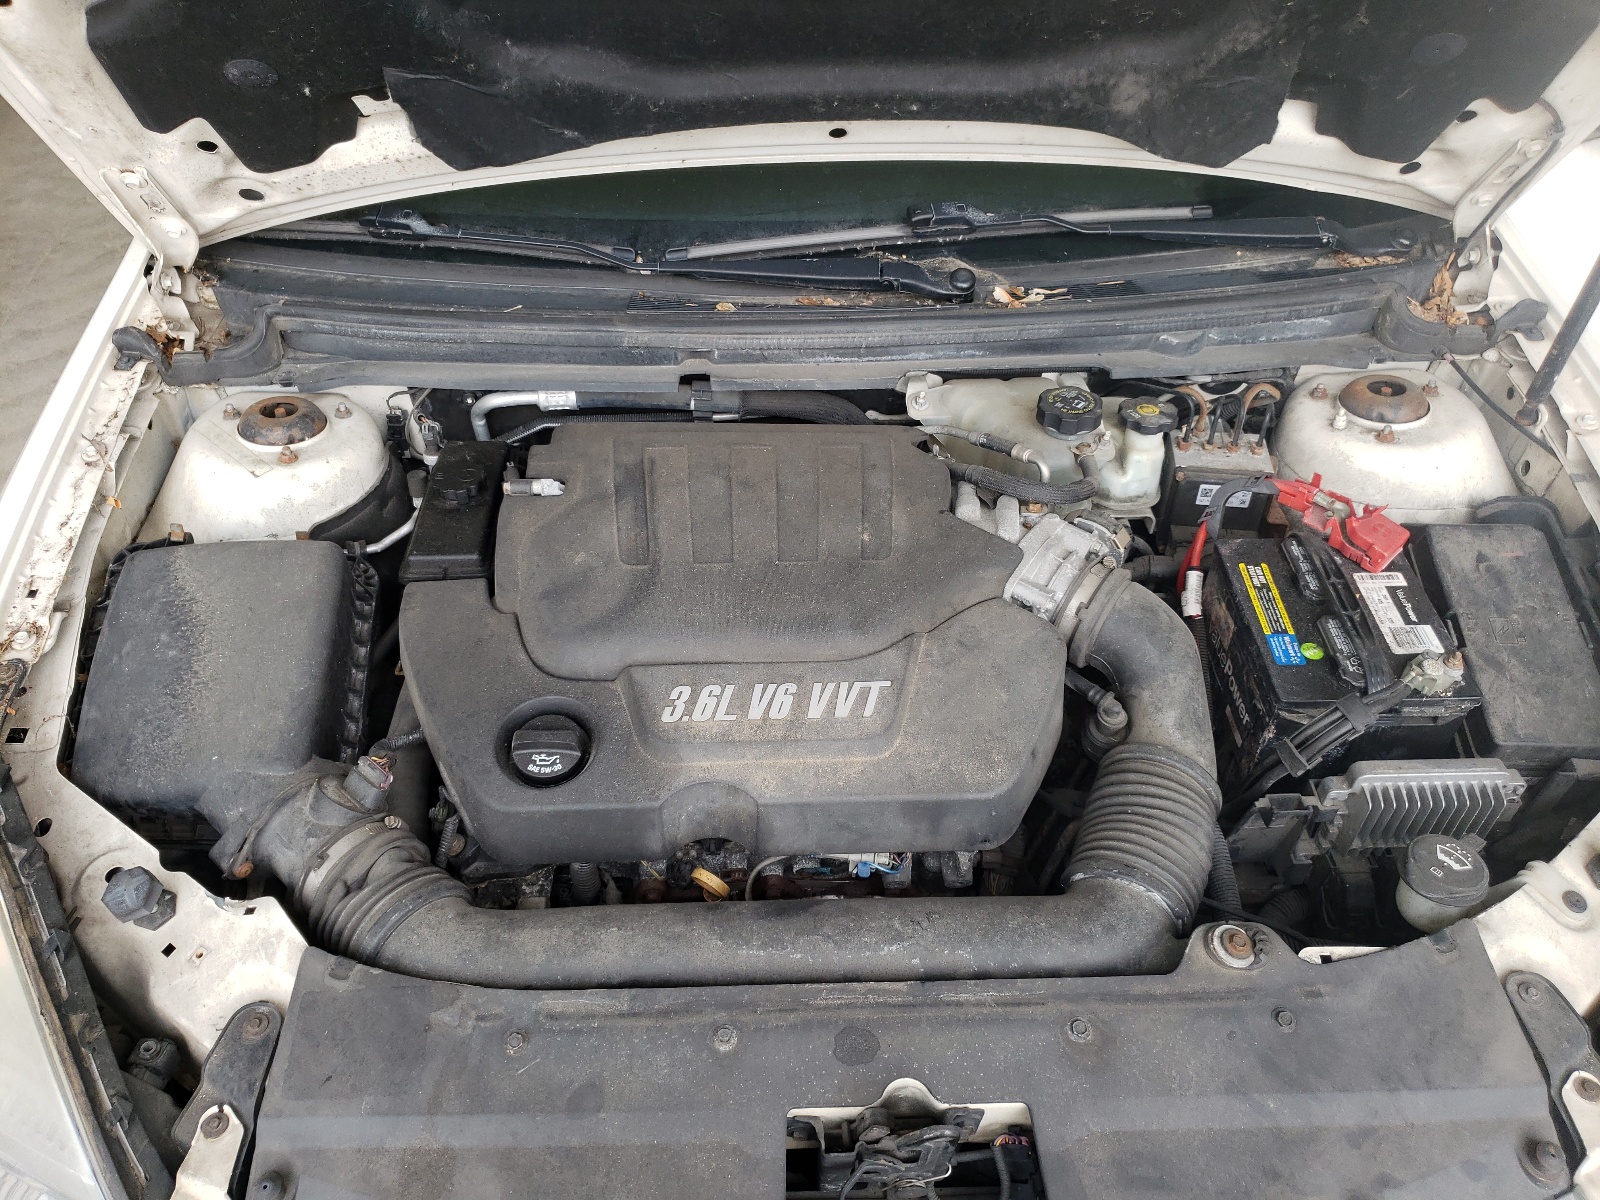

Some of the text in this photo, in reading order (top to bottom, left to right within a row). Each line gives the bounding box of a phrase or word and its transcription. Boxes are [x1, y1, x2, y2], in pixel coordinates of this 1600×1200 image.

[1395, 588, 1418, 622] ValuePower
[1211, 628, 1250, 725] aluePower
[661, 680, 892, 722] 3.6L V6 VVT
[527, 763, 562, 773] SAE 5W-30
